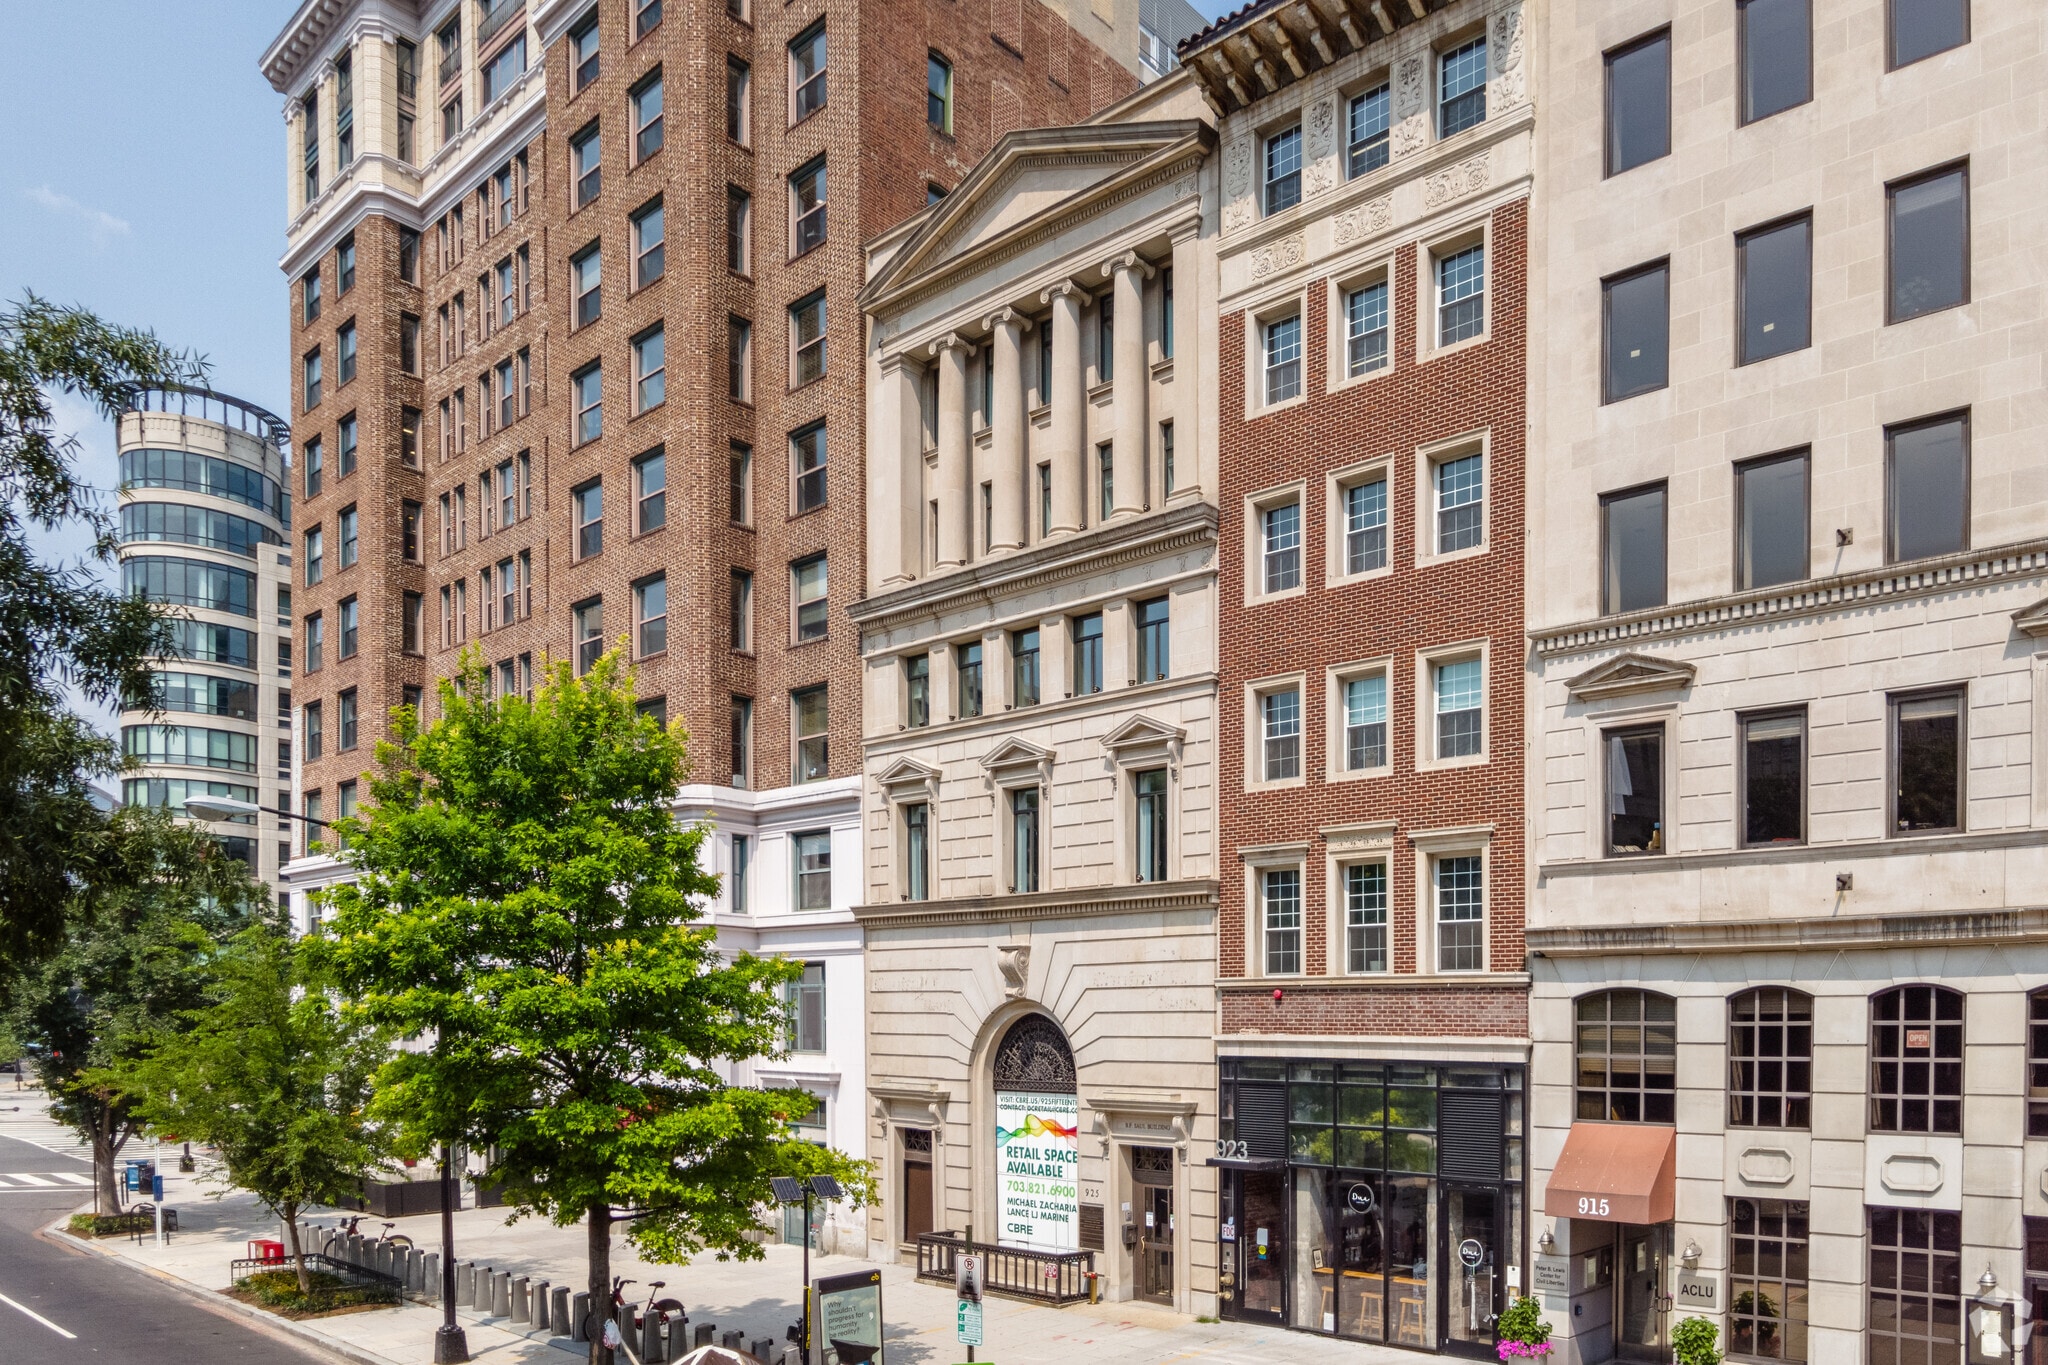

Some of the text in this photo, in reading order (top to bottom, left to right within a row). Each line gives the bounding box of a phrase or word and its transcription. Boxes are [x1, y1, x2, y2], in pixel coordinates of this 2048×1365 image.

[1909, 1034, 1928, 1042] OPEN
[1006, 1146, 1078, 1163] RETAIL SPACE
[1216, 1139, 1248, 1159] 923
[1006, 1161, 1063, 1178] AVAILABLE
[1007, 1180, 1076, 1198] 703.821.6900
[1085, 1188, 1100, 1198] 925
[1007, 1197, 1077, 1213] MICHAEL ZACHARIA
[1578, 1197, 1610, 1216] 915
[1007, 1207, 1069, 1223] LANCE LJ MARINE
[1007, 1223, 1033, 1235] CBRE
[1223, 1226, 1234, 1237] FDC
[1045, 1264, 1057, 1276] FDC
[1681, 1284, 1713, 1298] ACLU
[828, 1306, 857, 1316] shouldn't
[828, 1314, 855, 1324] progress
[829, 1321, 858, 1331] humanity
[837, 1327, 860, 1336] reality?
